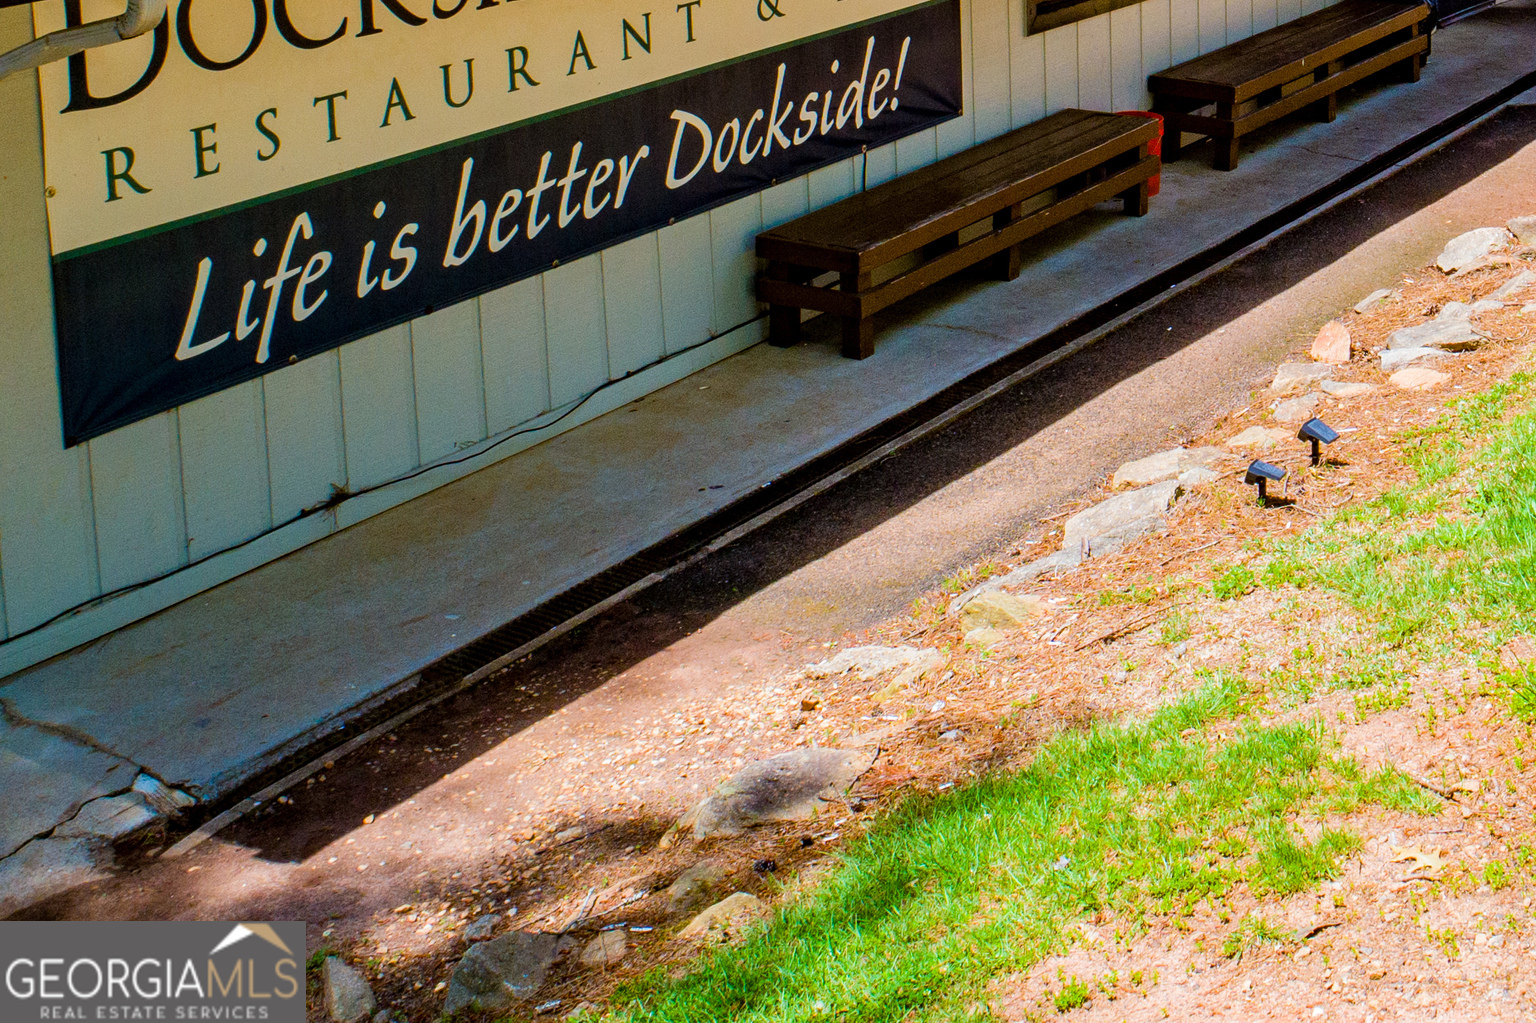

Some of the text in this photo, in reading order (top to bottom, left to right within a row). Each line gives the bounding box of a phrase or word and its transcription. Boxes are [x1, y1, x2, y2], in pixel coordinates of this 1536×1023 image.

[101, 0, 702, 203] RESTAURANT
[174, 36, 911, 364] Life is better Dockside!
